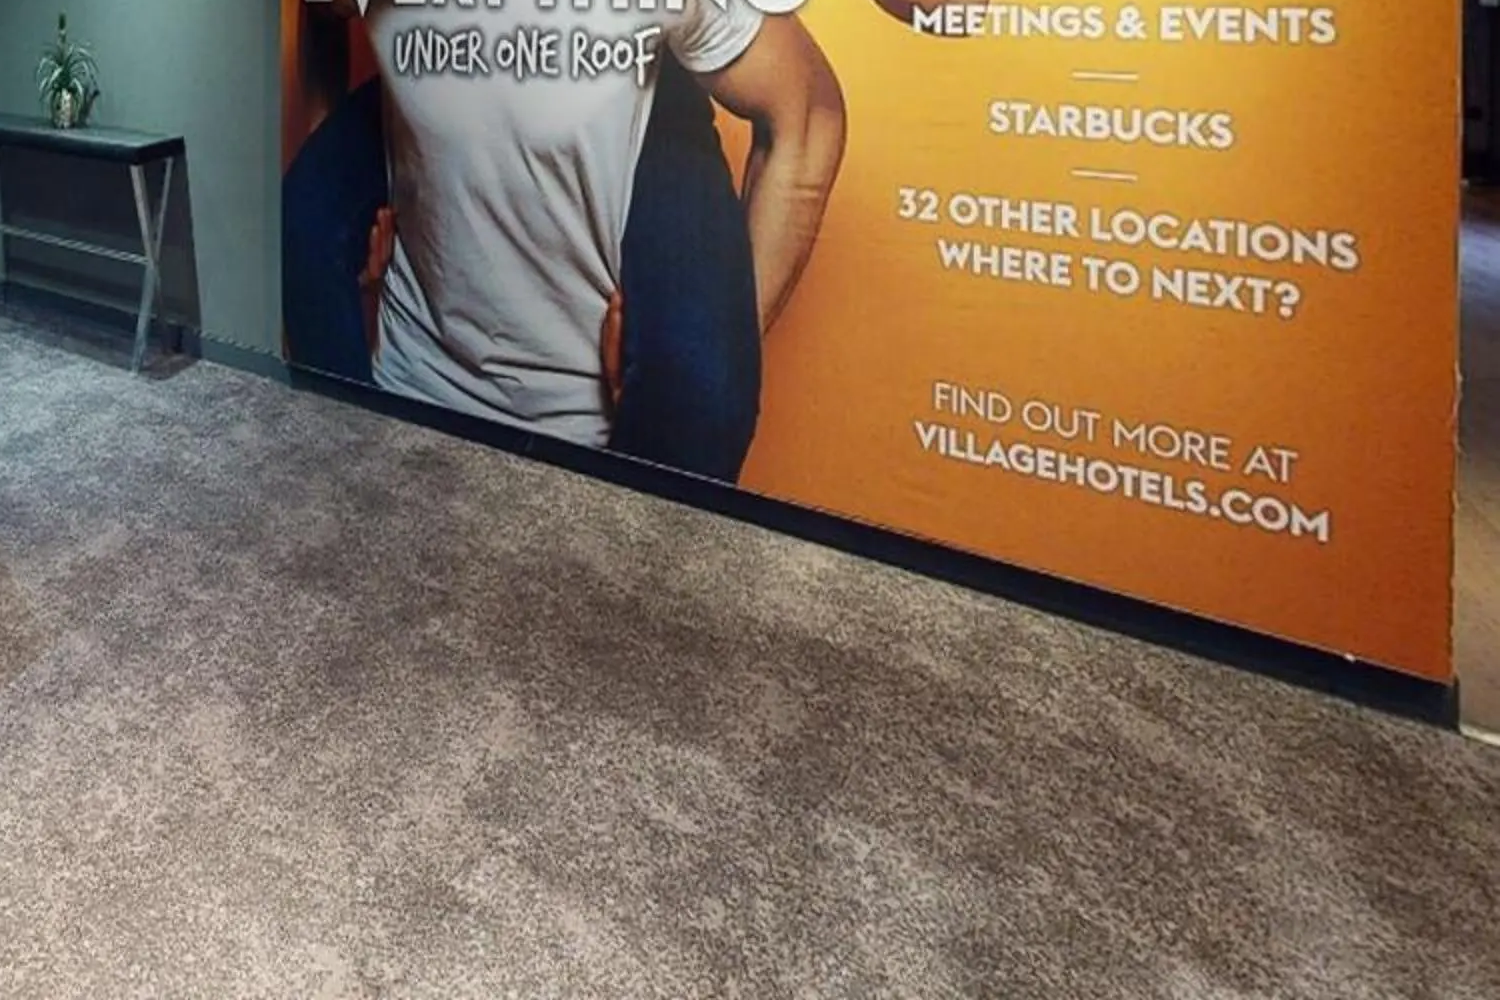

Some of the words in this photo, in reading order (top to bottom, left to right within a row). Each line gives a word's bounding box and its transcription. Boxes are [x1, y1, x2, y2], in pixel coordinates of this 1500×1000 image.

[395, 28, 488, 76] UNDER
[497, 28, 559, 80] ONE
[571, 27, 660, 86] ROOF
[913, 4, 1104, 38] MEETINGS
[1116, 6, 1146, 39] &
[1160, 7, 1335, 44] EVENTS
[989, 101, 1234, 148] STARBUCKS
[898, 188, 938, 220] 32
[949, 194, 1079, 238] OTHER
[1091, 209, 1359, 269] LOCATIONS
[938, 239, 1071, 286] WHERE
[1082, 257, 1140, 294] TO
[1153, 268, 1301, 319] NEXT?
[934, 382, 1011, 424] FIND
[1023, 400, 1100, 441] OUT
[1114, 419, 1230, 471] MORE
[1244, 446, 1297, 483] AT
[915, 421, 1330, 541] VILLAGEHOTELS.COM
